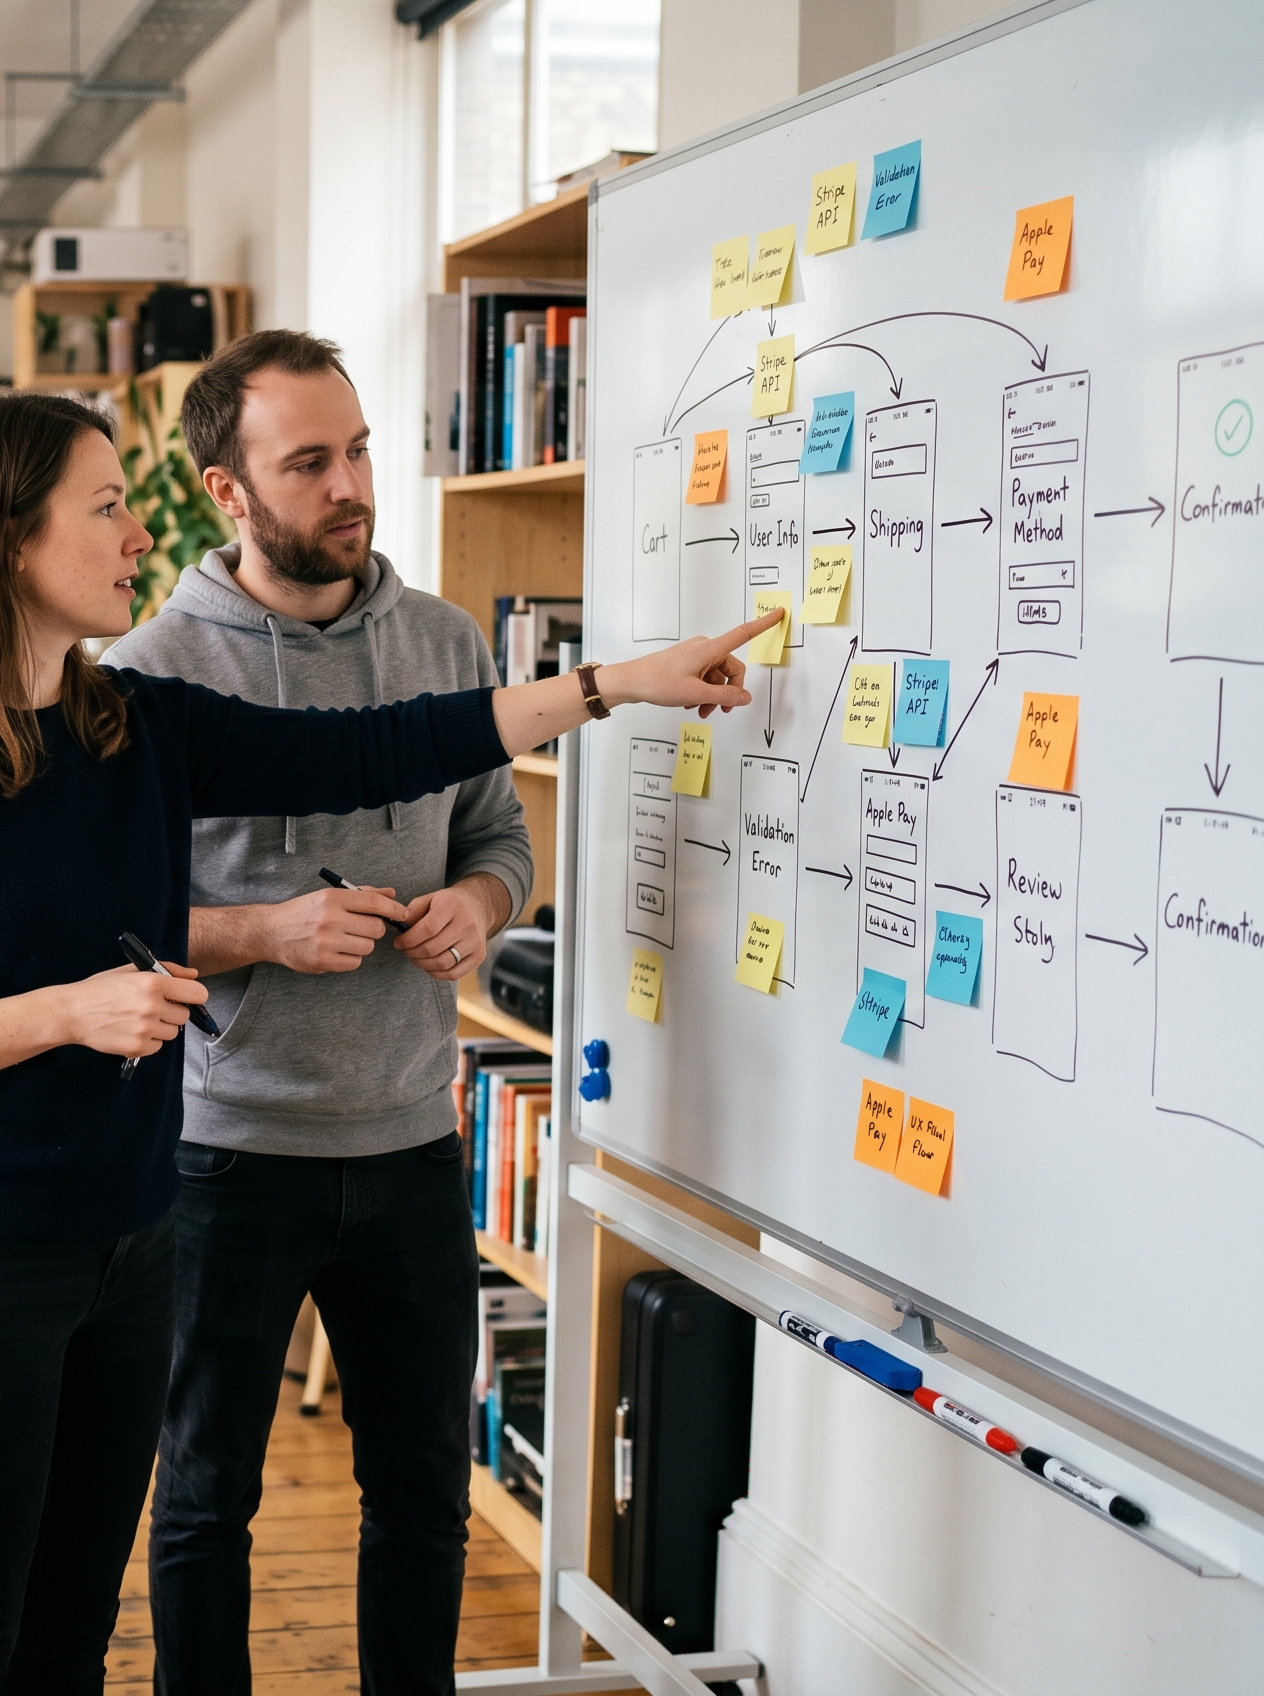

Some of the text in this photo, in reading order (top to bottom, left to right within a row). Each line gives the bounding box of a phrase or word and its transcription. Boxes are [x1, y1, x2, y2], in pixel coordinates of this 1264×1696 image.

[816, 185, 845, 206] Stripe
[817, 205, 839, 229] API
[1019, 218, 1053, 246] Apple
[1022, 249, 1045, 276] Pay
[760, 354, 787, 373] Stripe
[761, 374, 781, 394] API
[1011, 475, 1070, 519] Payment
[641, 523, 668, 554] Cart
[749, 519, 799, 548] User Info
[869, 508, 924, 553] Shipping
[1013, 514, 1064, 543] Method
[906, 698, 929, 715] API
[1026, 701, 1059, 730] Apple
[1029, 729, 1051, 760] Pay
[745, 812, 795, 844] Validation
[866, 797, 917, 836] Apple Pay
[752, 850, 782, 878] Error
[1008, 857, 1062, 900] Review
[866, 1091, 893, 1119] Apple
[868, 1121, 886, 1151] Pay
[911, 1115, 923, 1131] UX
